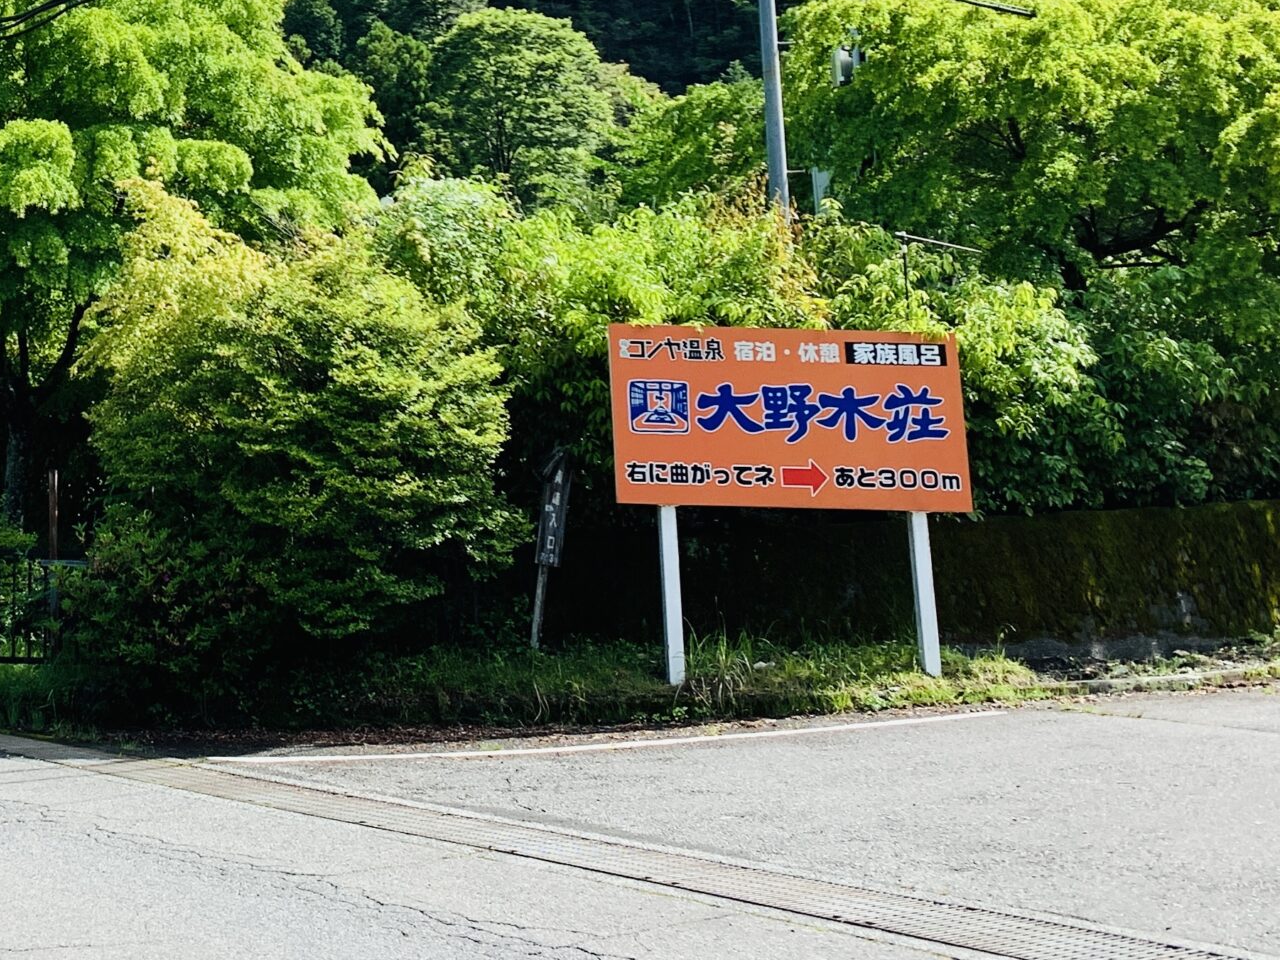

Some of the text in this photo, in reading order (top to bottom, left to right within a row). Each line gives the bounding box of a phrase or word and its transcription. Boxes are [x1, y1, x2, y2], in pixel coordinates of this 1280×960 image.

[853, 343, 941, 366] 家族風呂
[696, 382, 950, 443] 大野木荘
[625, 461, 775, 486] 右に曲がってネ
